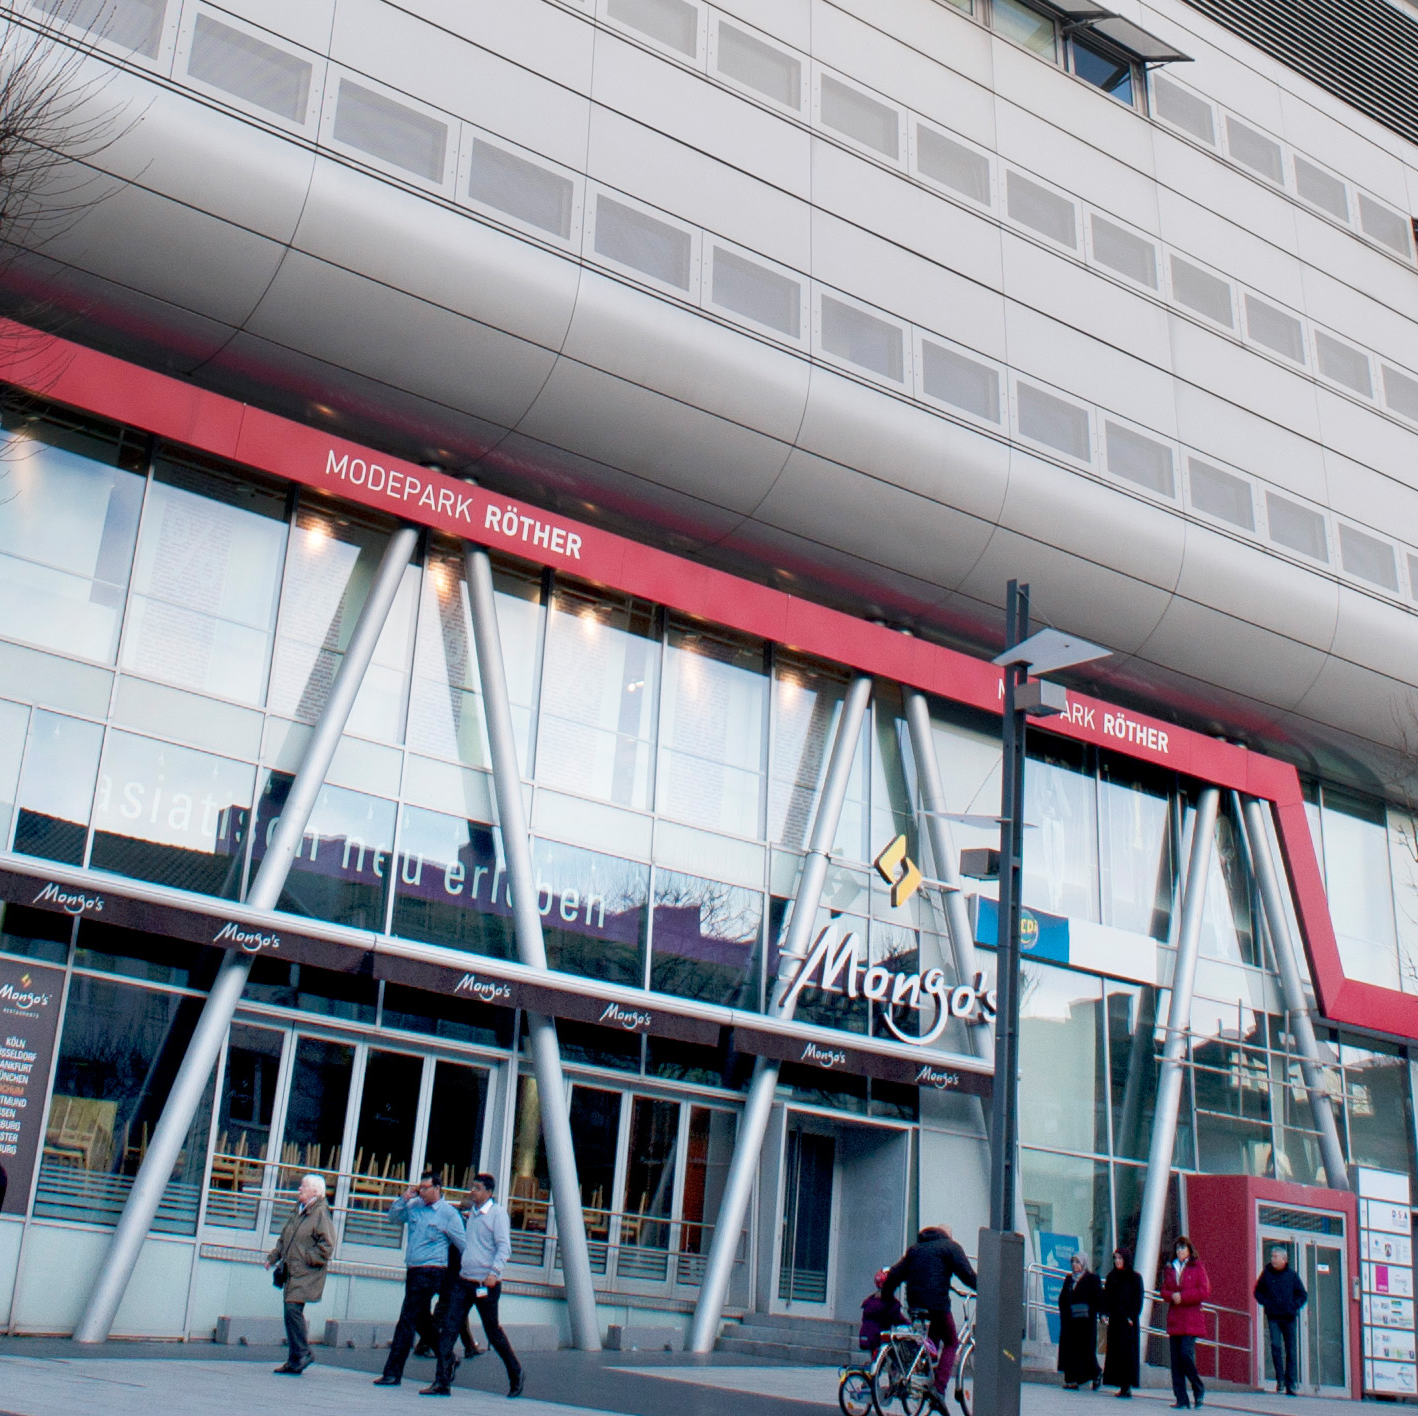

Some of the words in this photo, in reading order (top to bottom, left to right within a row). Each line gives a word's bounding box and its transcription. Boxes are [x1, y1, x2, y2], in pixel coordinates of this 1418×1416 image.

[325, 450, 474, 523] MODEPARK
[484, 505, 582, 560] RÖTHER
[1103, 712, 1169, 754] RÖTHER
[33, 882, 105, 914] Mongo's
[444, 857, 606, 929] erlben
[212, 922, 280, 952] Mongo's
[454, 972, 512, 1001] Mongo's
[781, 922, 997, 1046] Mongo's
[599, 1001, 652, 1030] Mongo's
[6, 1036, 26, 1049] KÖLN
[801, 1041, 846, 1068] Mongo's
[915, 1064, 959, 1088] Mongo's
